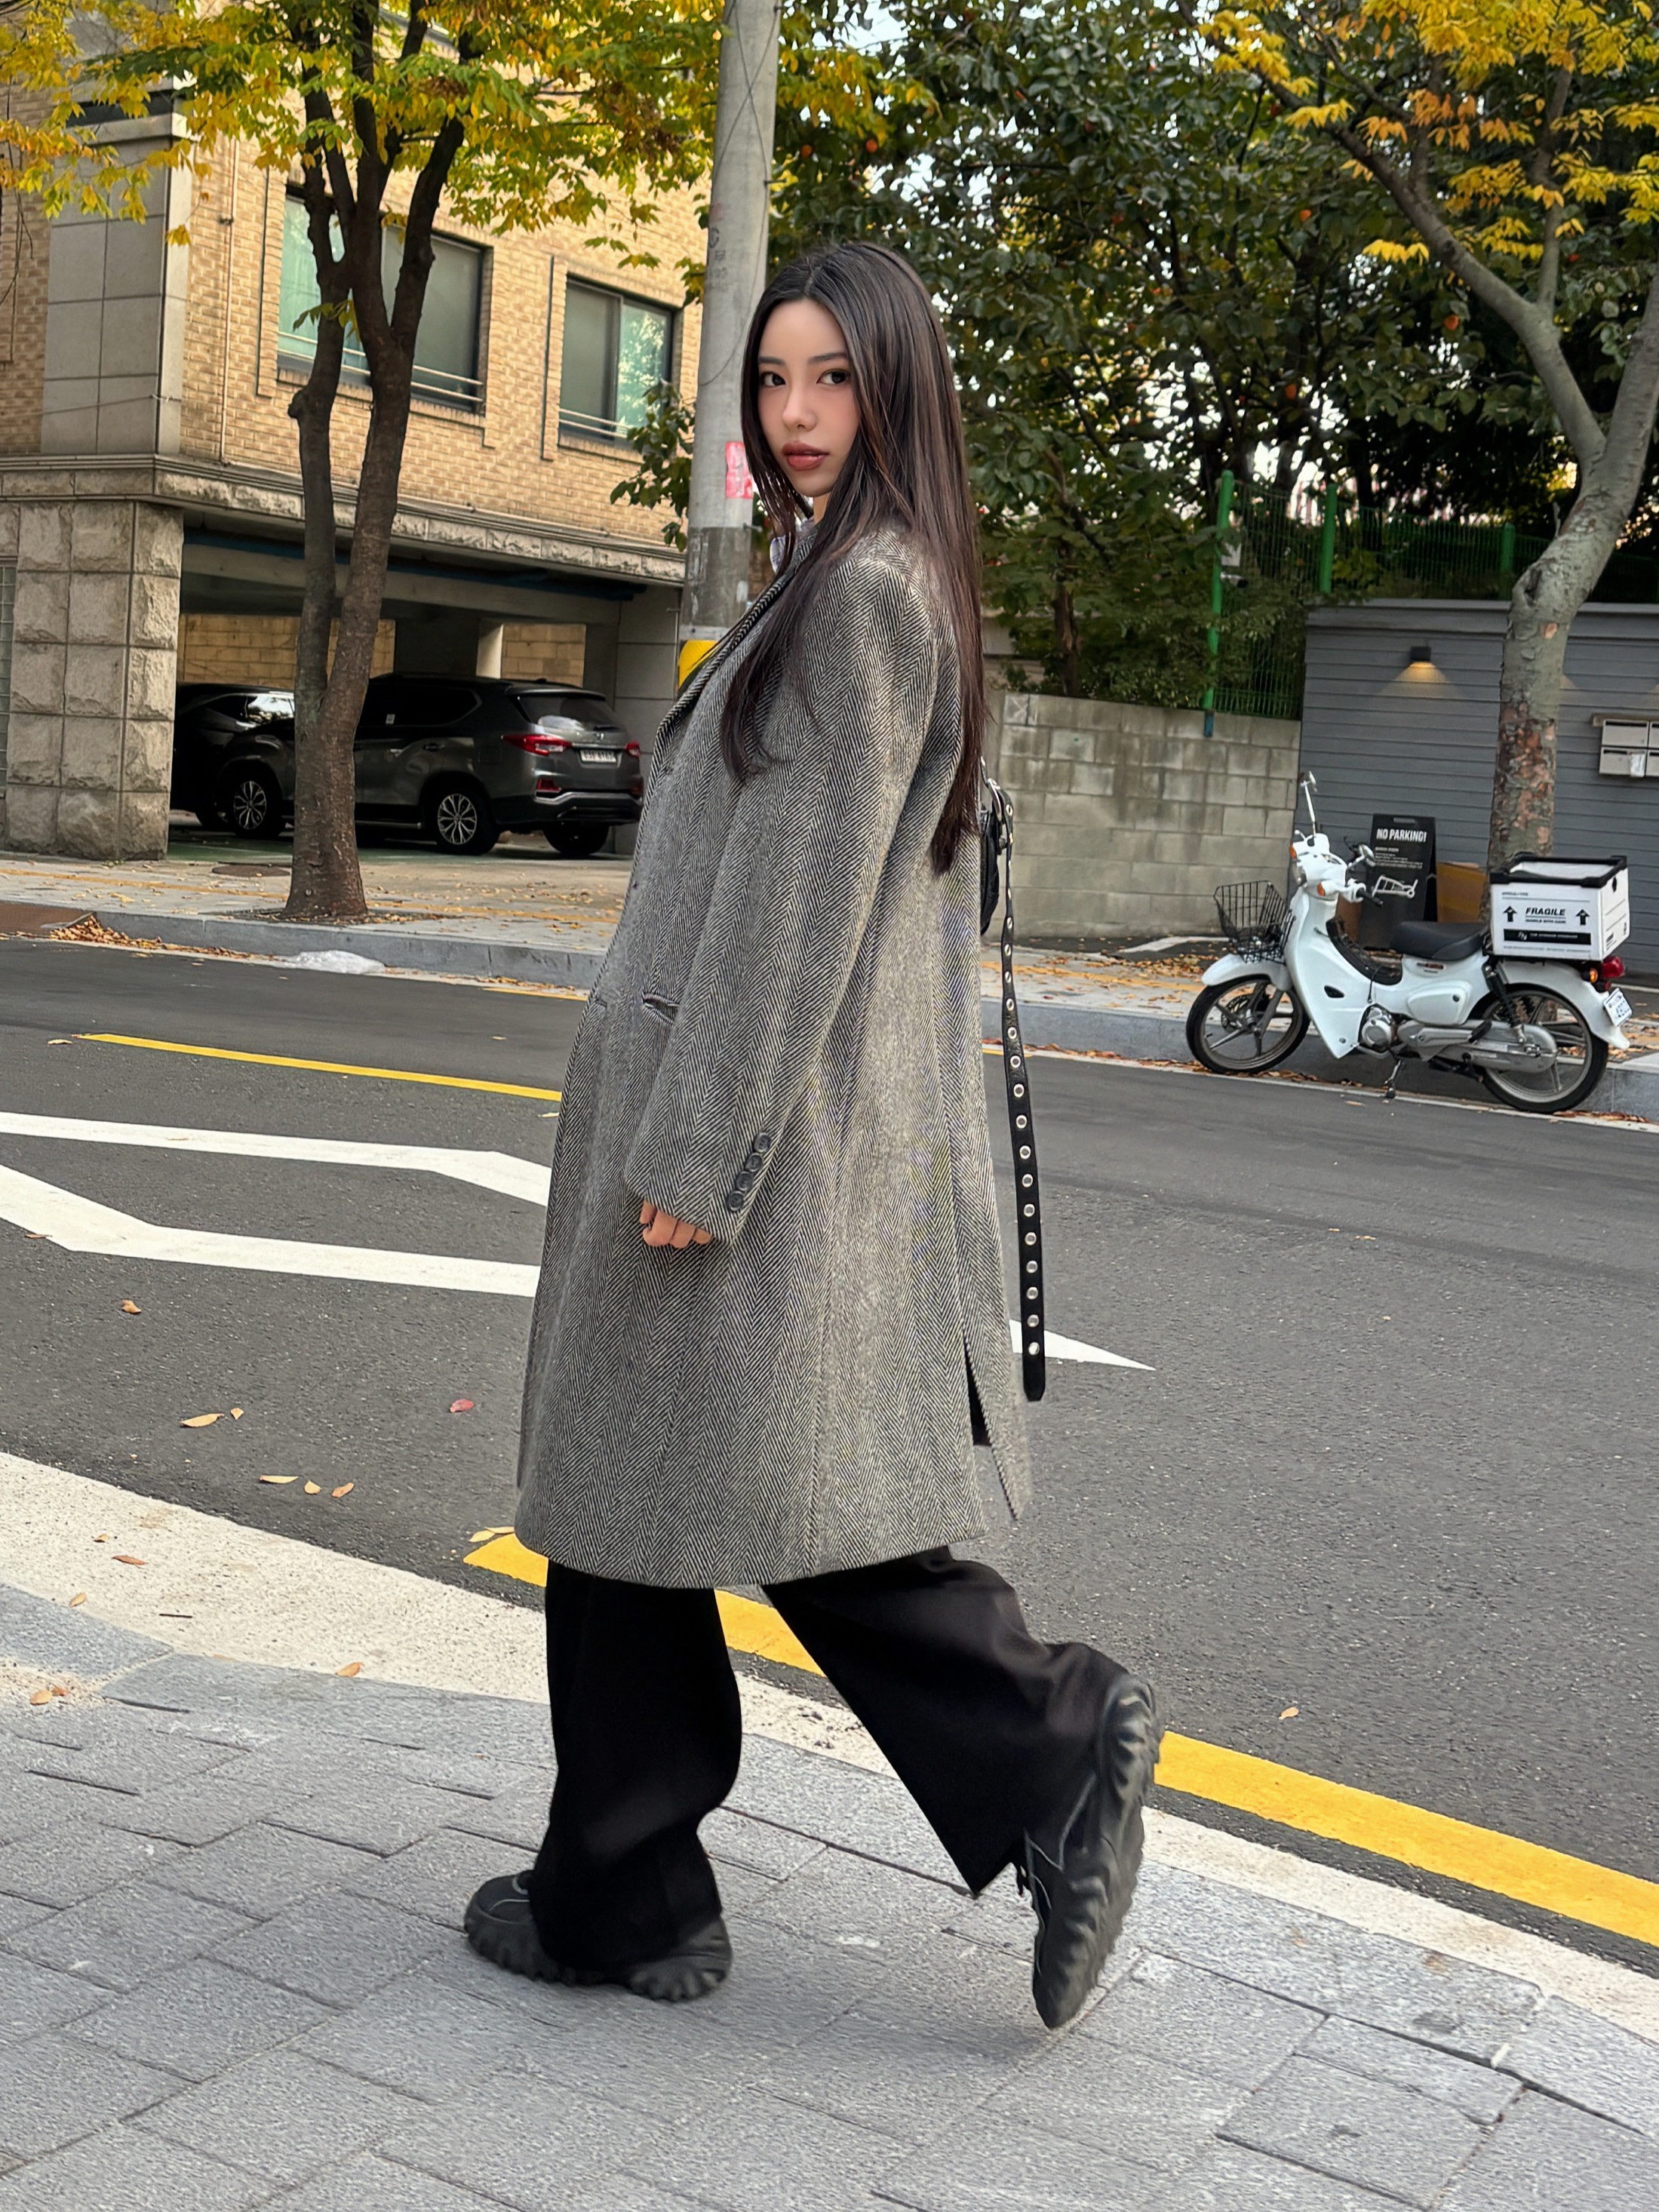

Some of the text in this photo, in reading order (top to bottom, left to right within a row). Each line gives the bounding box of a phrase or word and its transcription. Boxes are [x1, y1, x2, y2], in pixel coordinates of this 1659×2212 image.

[1376, 828, 1427, 843] NO PARKING!
[1525, 907, 1566, 916] FRAGILE
